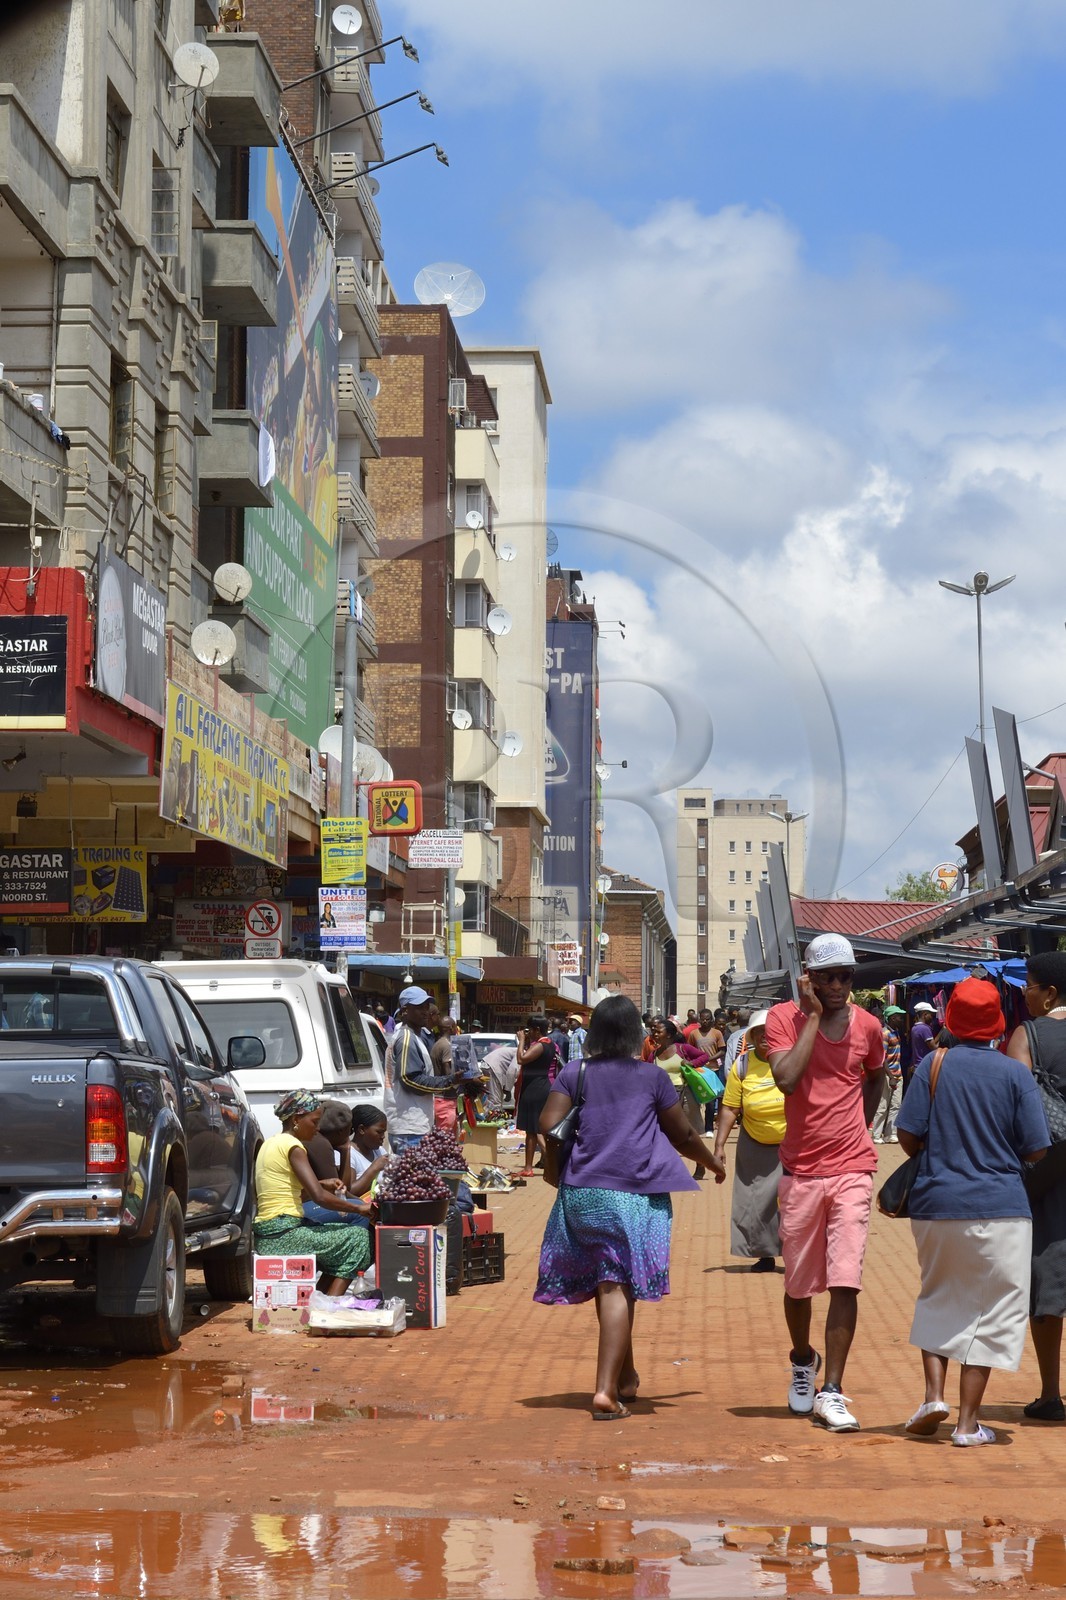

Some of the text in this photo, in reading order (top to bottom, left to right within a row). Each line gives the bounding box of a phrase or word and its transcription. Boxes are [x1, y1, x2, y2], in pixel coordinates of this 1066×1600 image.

[247, 522, 316, 634] AND SUPPORT LOCAL
[133, 582, 165, 637] MEGASTAR
[142, 627, 158, 656] LIQUOR
[6, 665, 58, 673] RESTAURANT
[175, 693, 194, 739] ALL
[197, 706, 240, 768] FARZANA
[243, 736, 278, 791] TRADING
[544, 835, 576, 852] ATION
[82, 848, 132, 864] TRADING
[12, 870, 68, 879] RESTAURANT
[2, 893, 48, 901] NOORD ST.
[32, 1074, 76, 1083] HILUX
[415, 1245, 425, 1275] Cool
[416, 1282, 428, 1312] Cape
